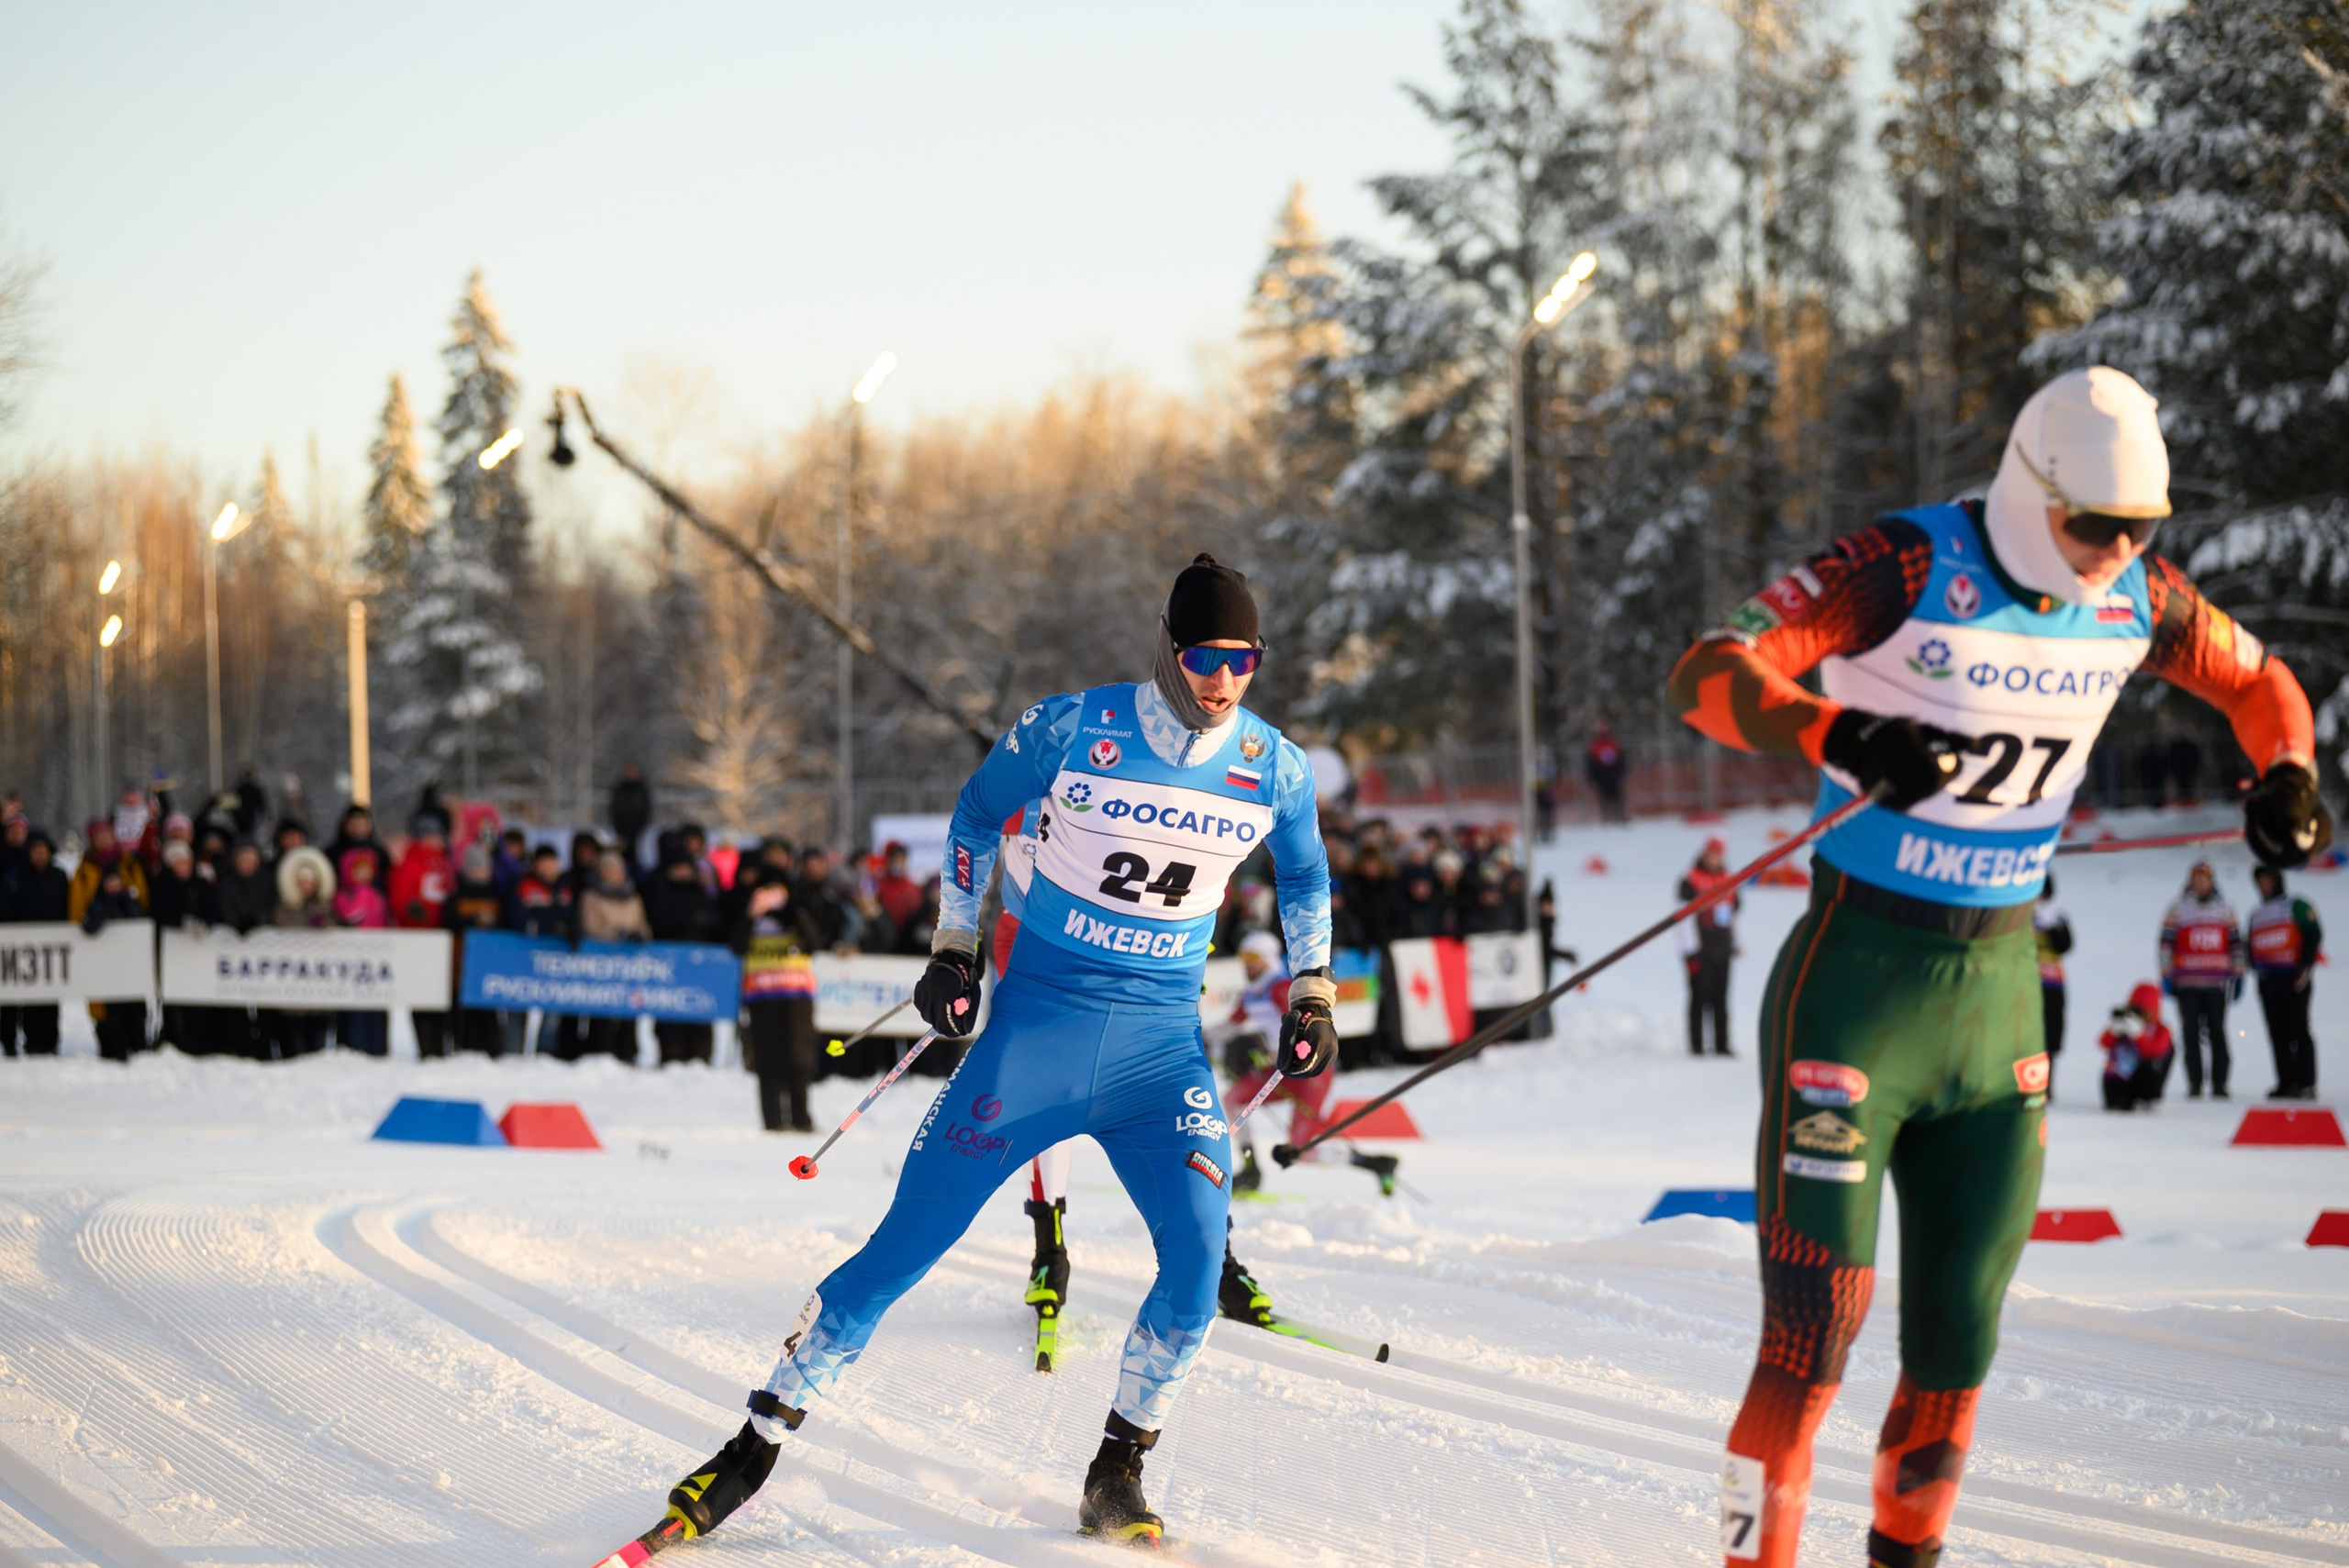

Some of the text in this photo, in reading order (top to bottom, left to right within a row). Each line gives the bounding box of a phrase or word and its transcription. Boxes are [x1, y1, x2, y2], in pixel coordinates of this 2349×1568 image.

[1967, 662, 2131, 695] ФОСАГРО
[1083, 727, 1132, 738] РУСКЛИМАТ
[1954, 731, 2072, 807] 27
[1102, 799, 1255, 842] ФОСАГРО
[1098, 851, 1197, 906] 24
[1063, 908, 1190, 958] ИЖЕВСК
[217, 955, 393, 984] БАРРАКУДА
[530, 950, 675, 983] ТЕХНОПАРК
[1187, 1129, 1221, 1141] ENERGY
[950, 1143, 987, 1161] ENERGY
[1189, 1151, 1225, 1187] RUSSIA
